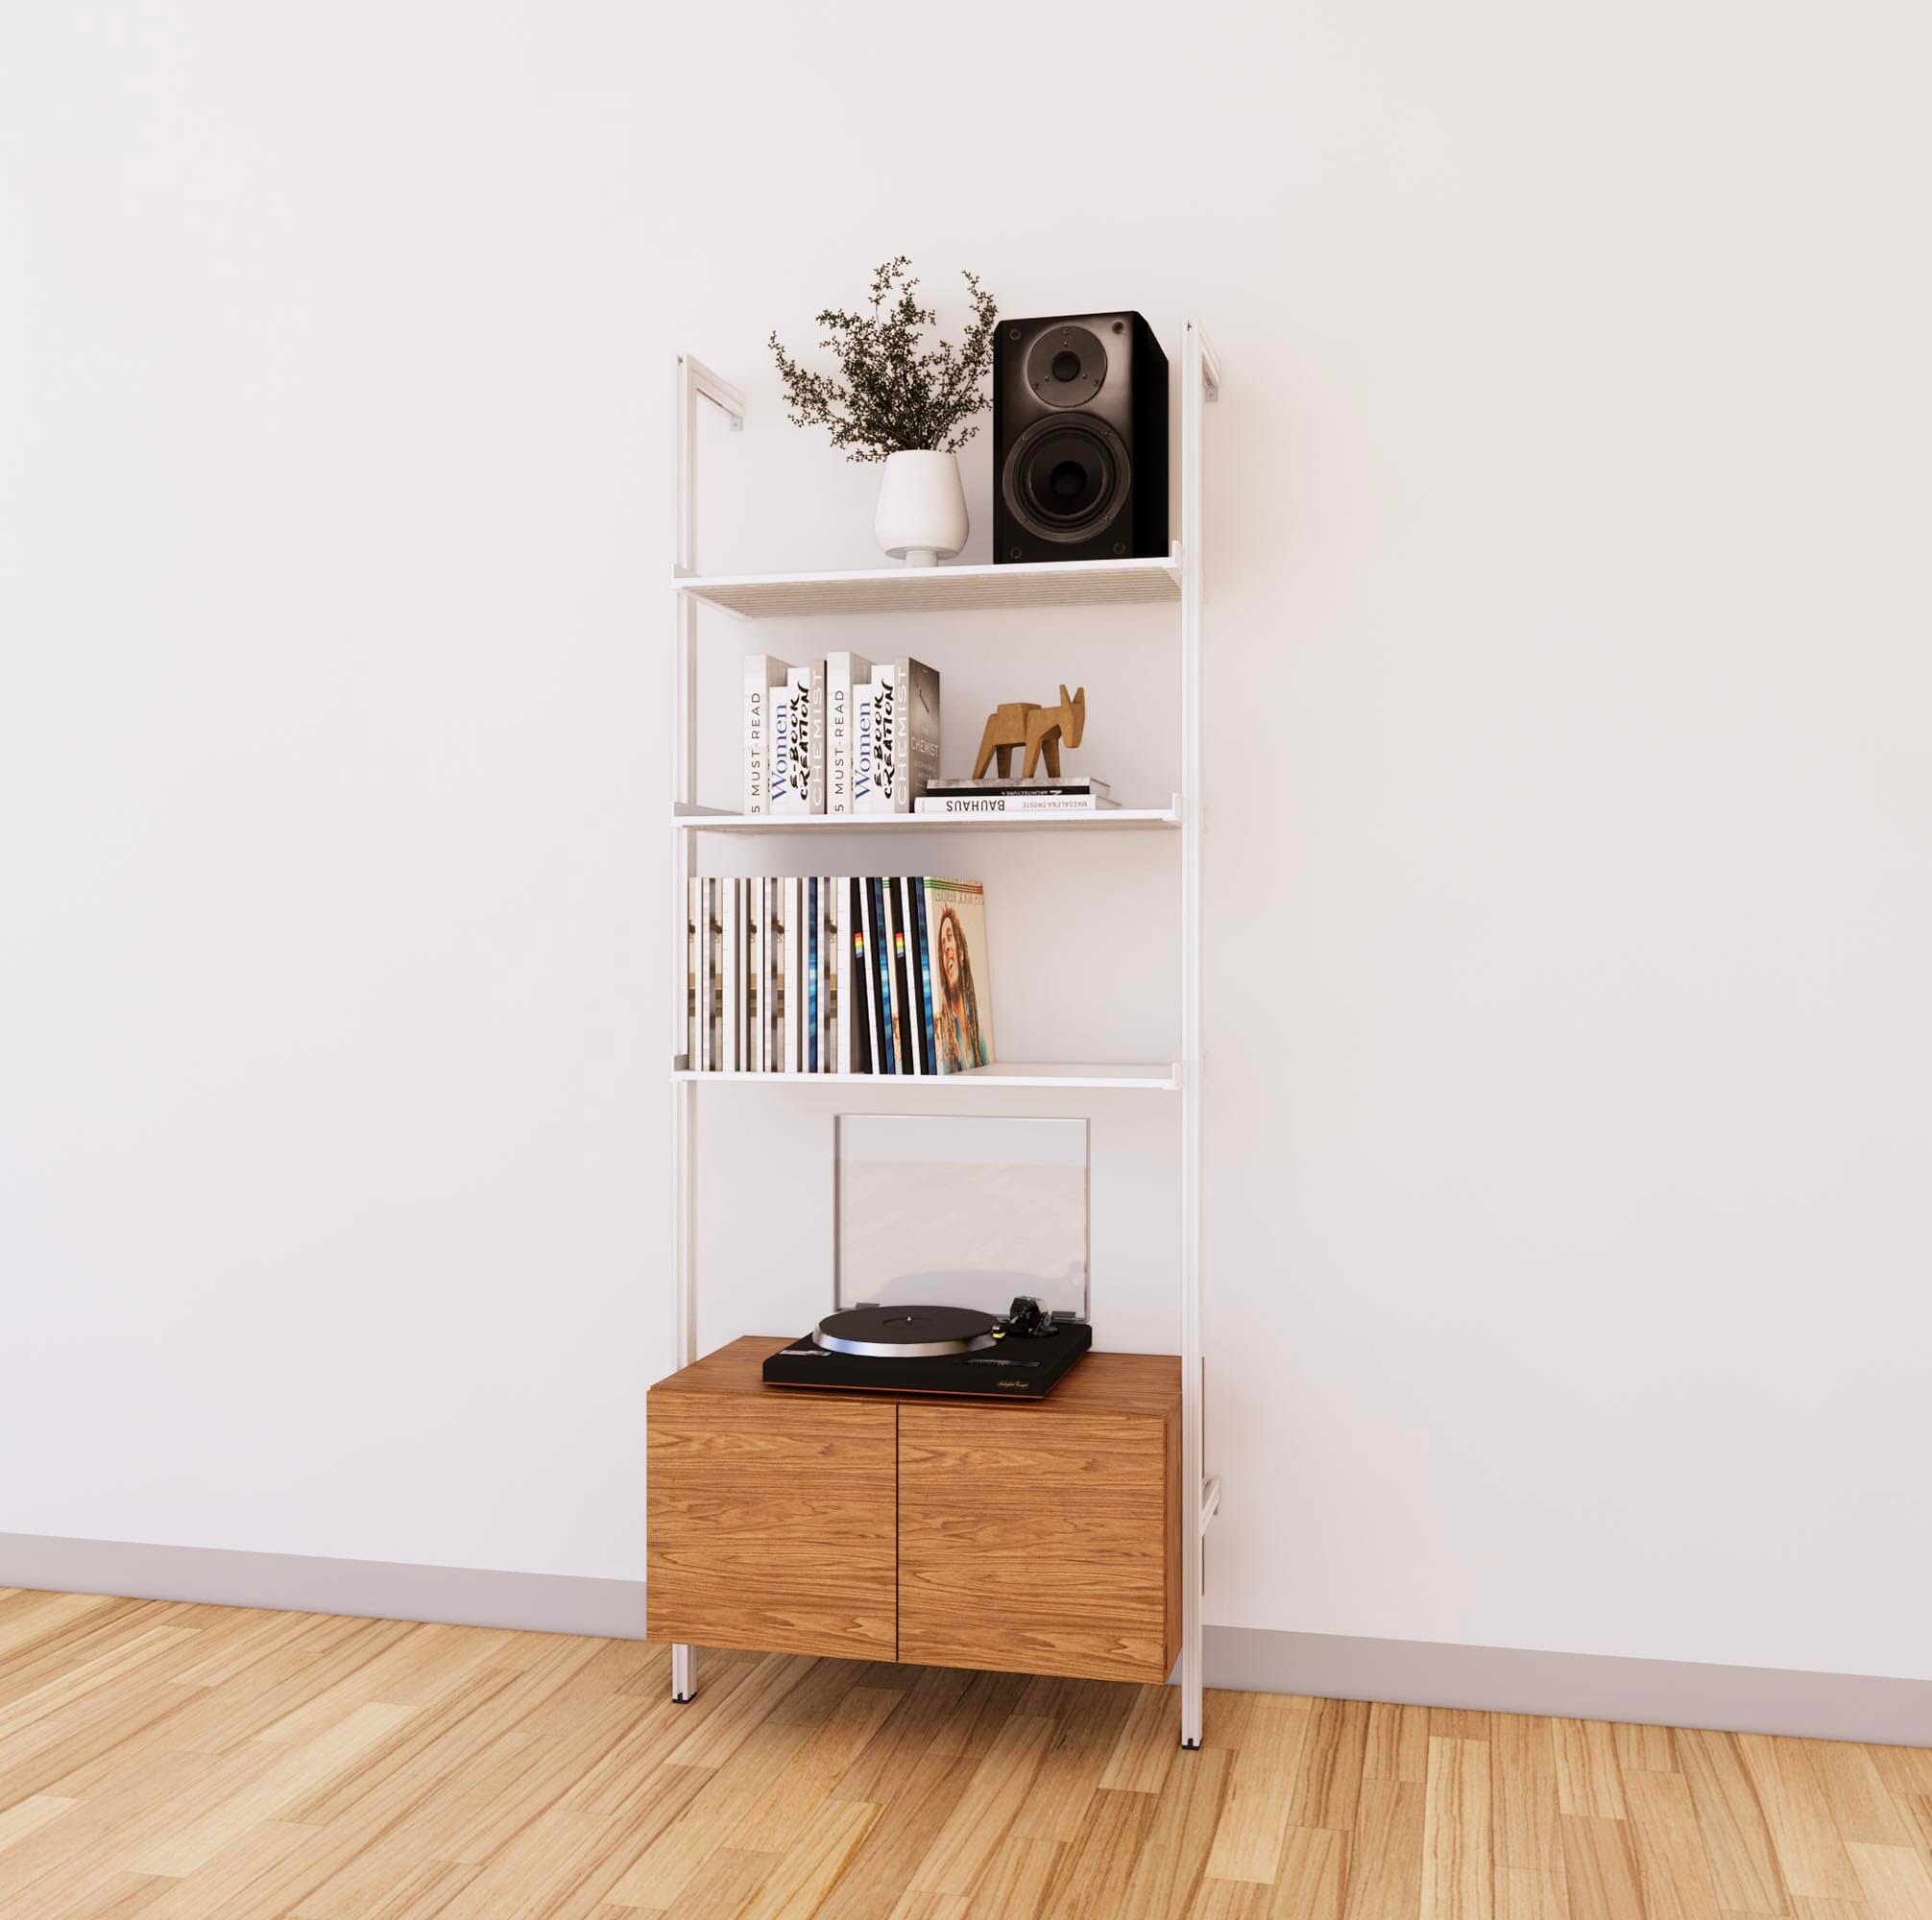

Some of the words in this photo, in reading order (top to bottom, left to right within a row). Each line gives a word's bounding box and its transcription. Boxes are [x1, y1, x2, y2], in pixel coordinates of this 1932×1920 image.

[751, 692, 761, 796] MUST-READ
[771, 704, 787, 801] Women
[790, 694, 800, 789] E-BOOK
[798, 681, 810, 801] CREATION
[813, 667, 823, 806] CHEMIST
[834, 690, 844, 795] MUST-READ
[855, 702, 871, 800] Women
[874, 691, 884, 787] E-BOOK
[881, 678, 895, 800] CREATION
[898, 667, 907, 804] CHEMIST
[910, 736, 939, 757] CHEMIST
[751, 804, 761, 813] 5
[834, 804, 844, 812] 5
[946, 800, 1005, 811] BAUHAUS
